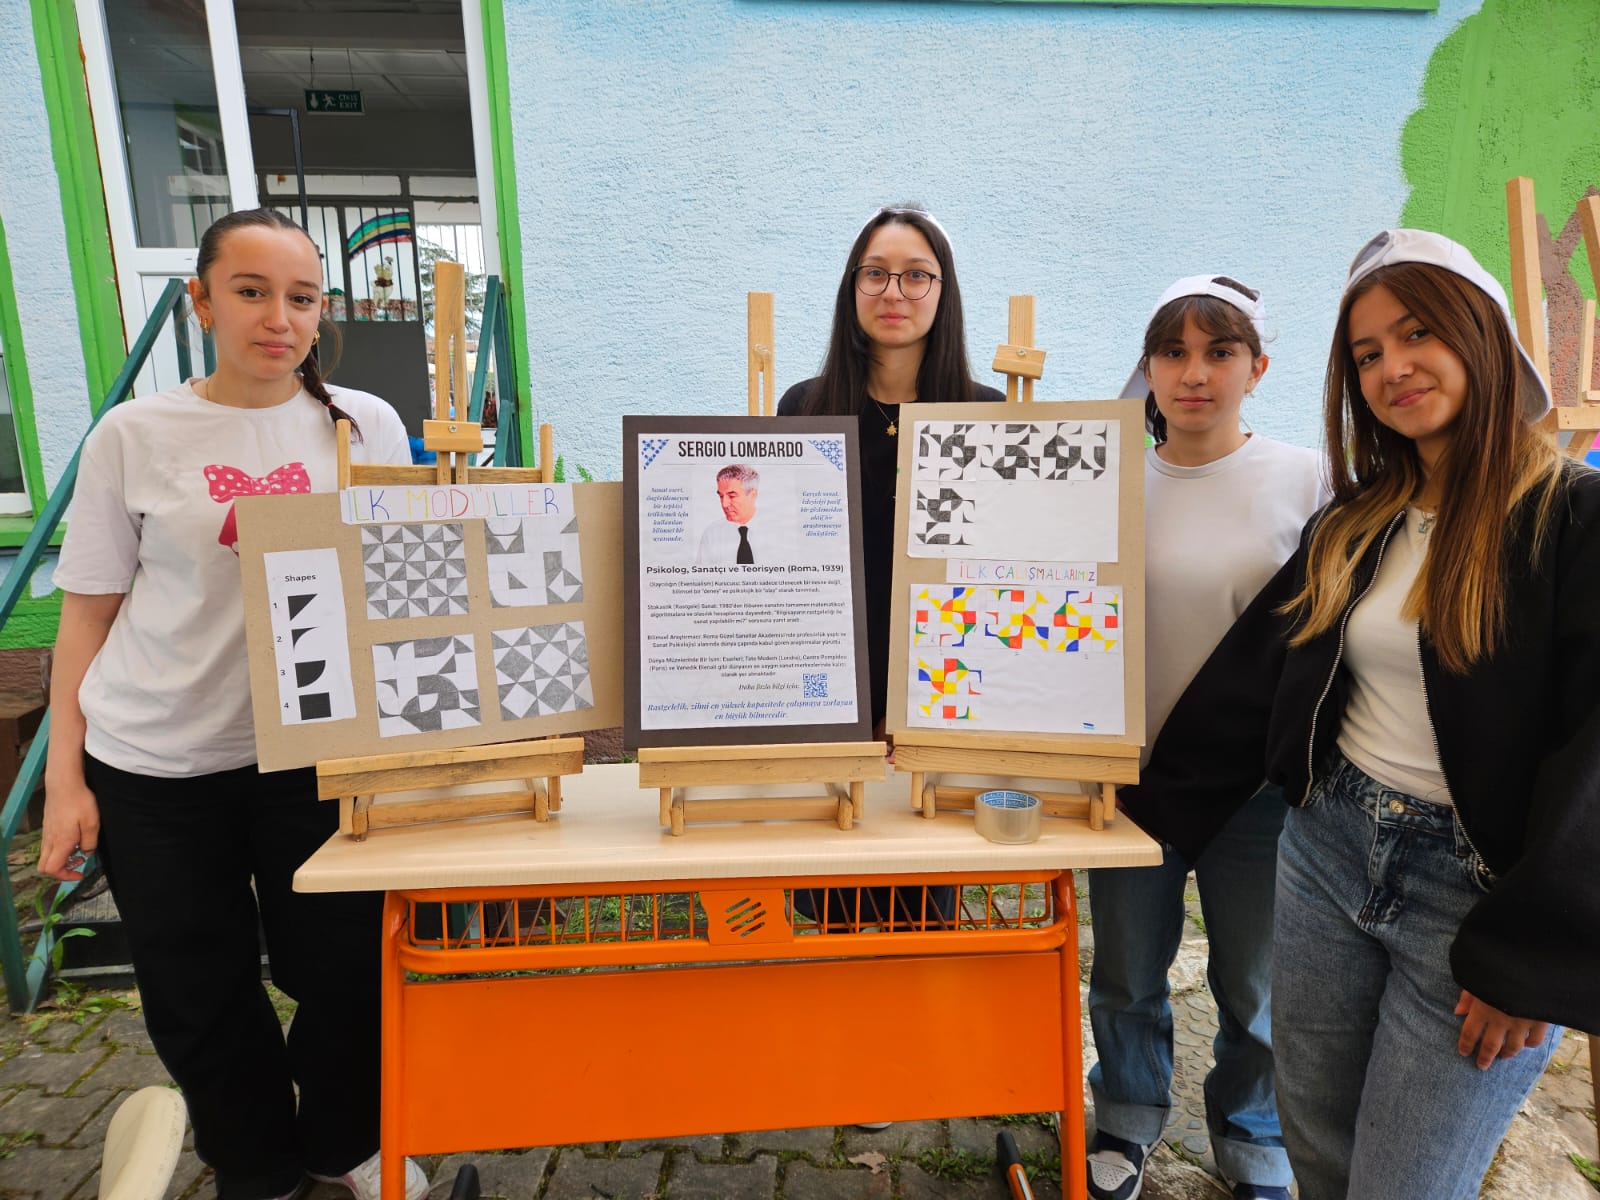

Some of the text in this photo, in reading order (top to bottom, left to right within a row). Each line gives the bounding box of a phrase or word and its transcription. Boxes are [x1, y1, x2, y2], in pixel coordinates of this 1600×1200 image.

[678, 441, 803, 458] SERGIO LOMBARDO
[407, 486, 559, 518] MODÜLLER
[646, 566, 689, 575] Psikolog,
[691, 565, 726, 575] Sanatçı
[742, 565, 785, 575] Teorisyen
[787, 564, 819, 574] (Roma,
[821, 564, 844, 574] 1939)
[960, 562, 1095, 582] İLK ÇALIŞMALARIMIZ
[285, 574, 317, 583] Shapes
